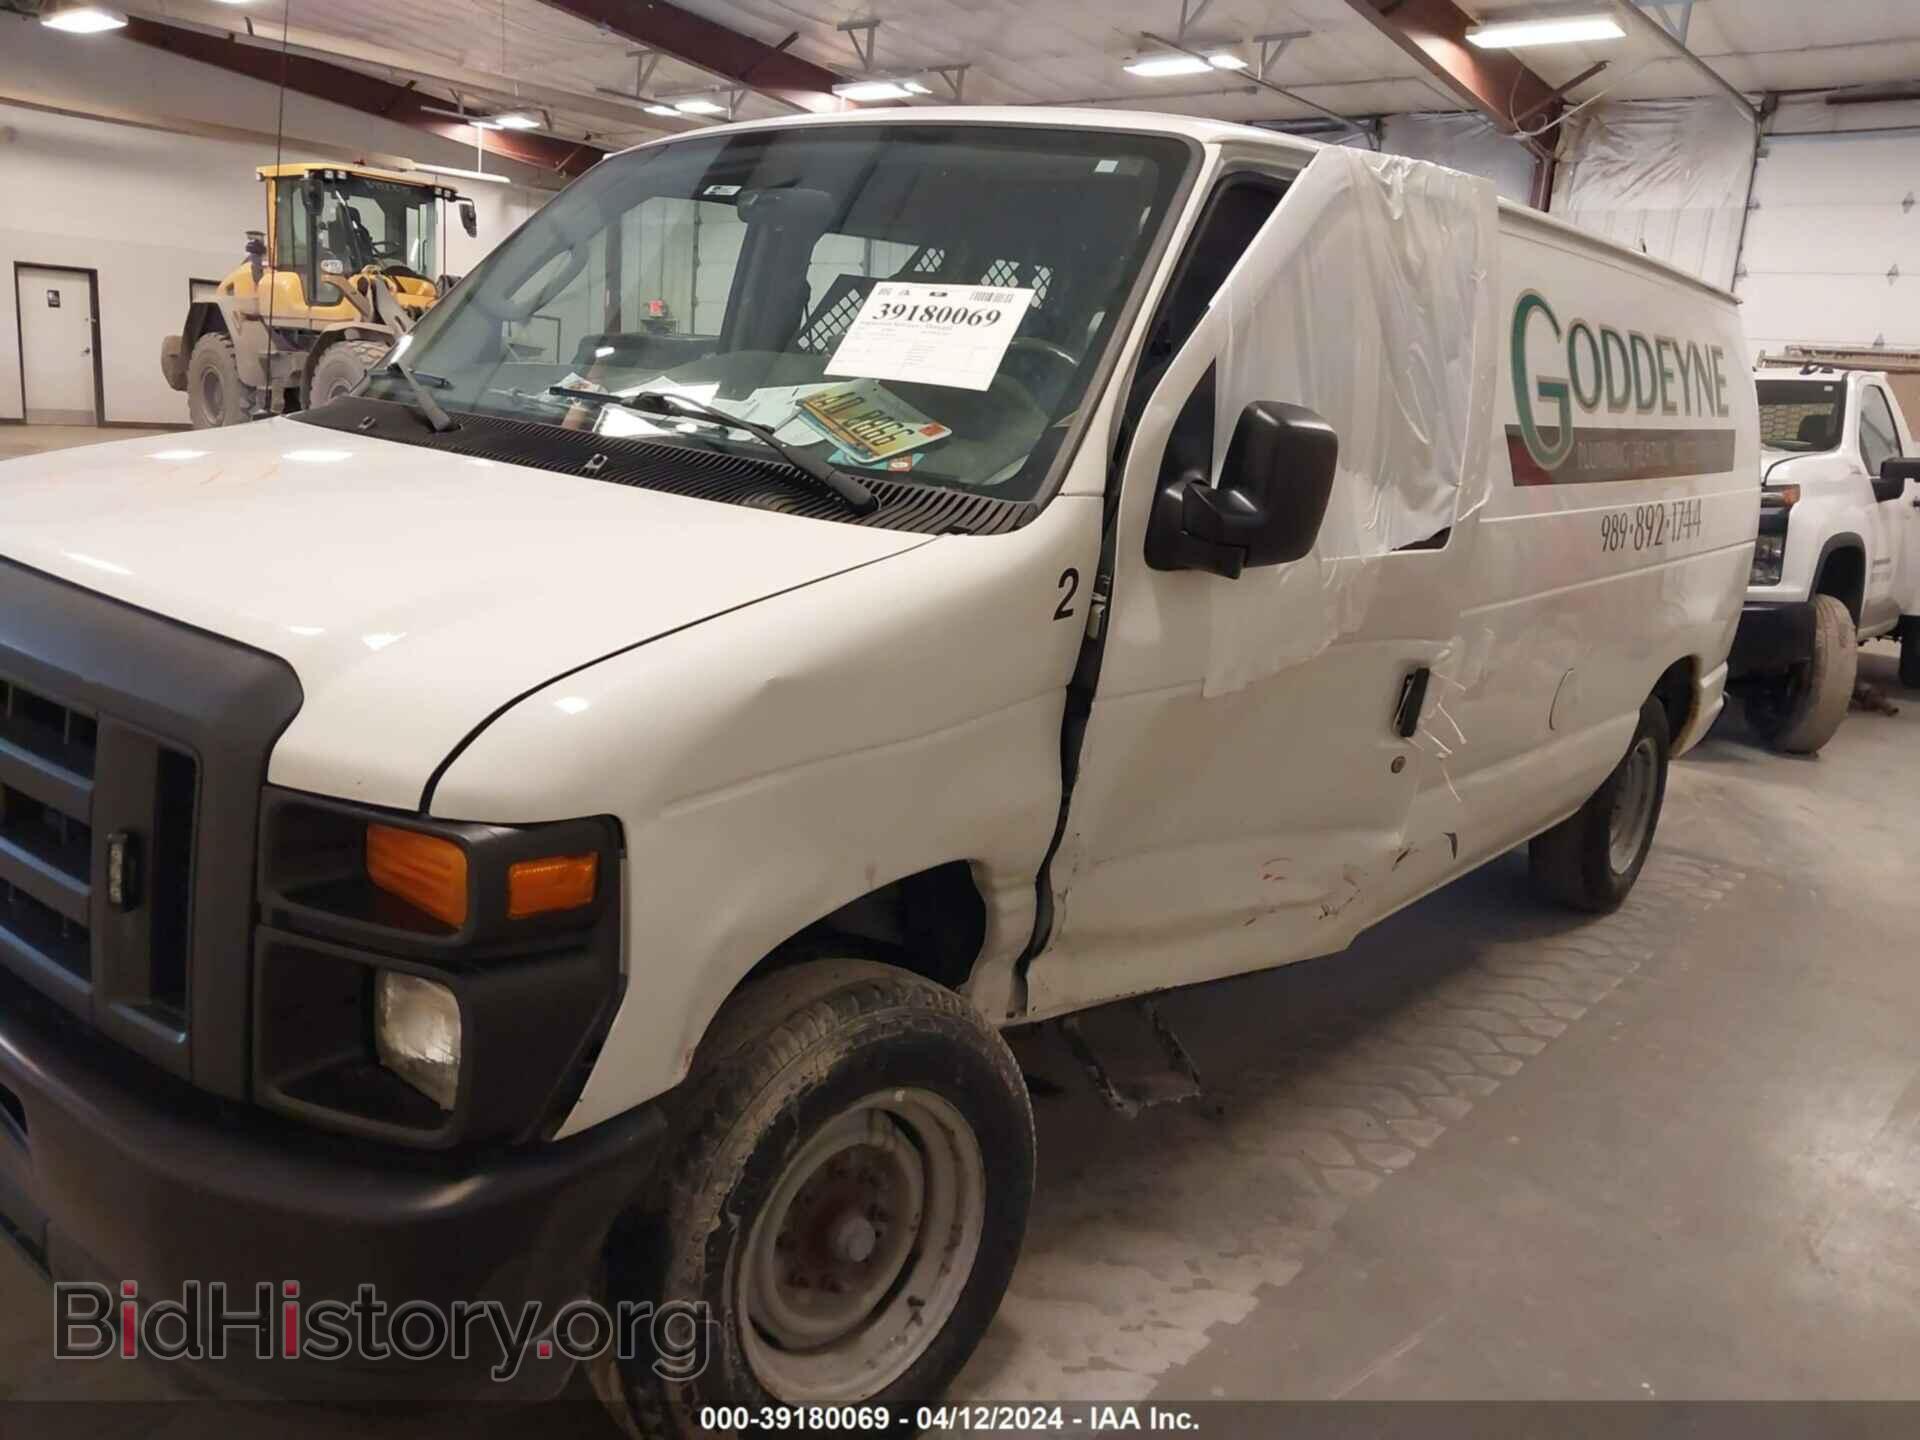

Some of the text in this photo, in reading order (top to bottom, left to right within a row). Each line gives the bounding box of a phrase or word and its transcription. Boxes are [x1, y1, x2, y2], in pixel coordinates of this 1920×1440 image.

[872, 302, 1002, 328] 39180069
[1510, 288, 1729, 471] GODDEYNE
[1053, 567, 1080, 621] 2
